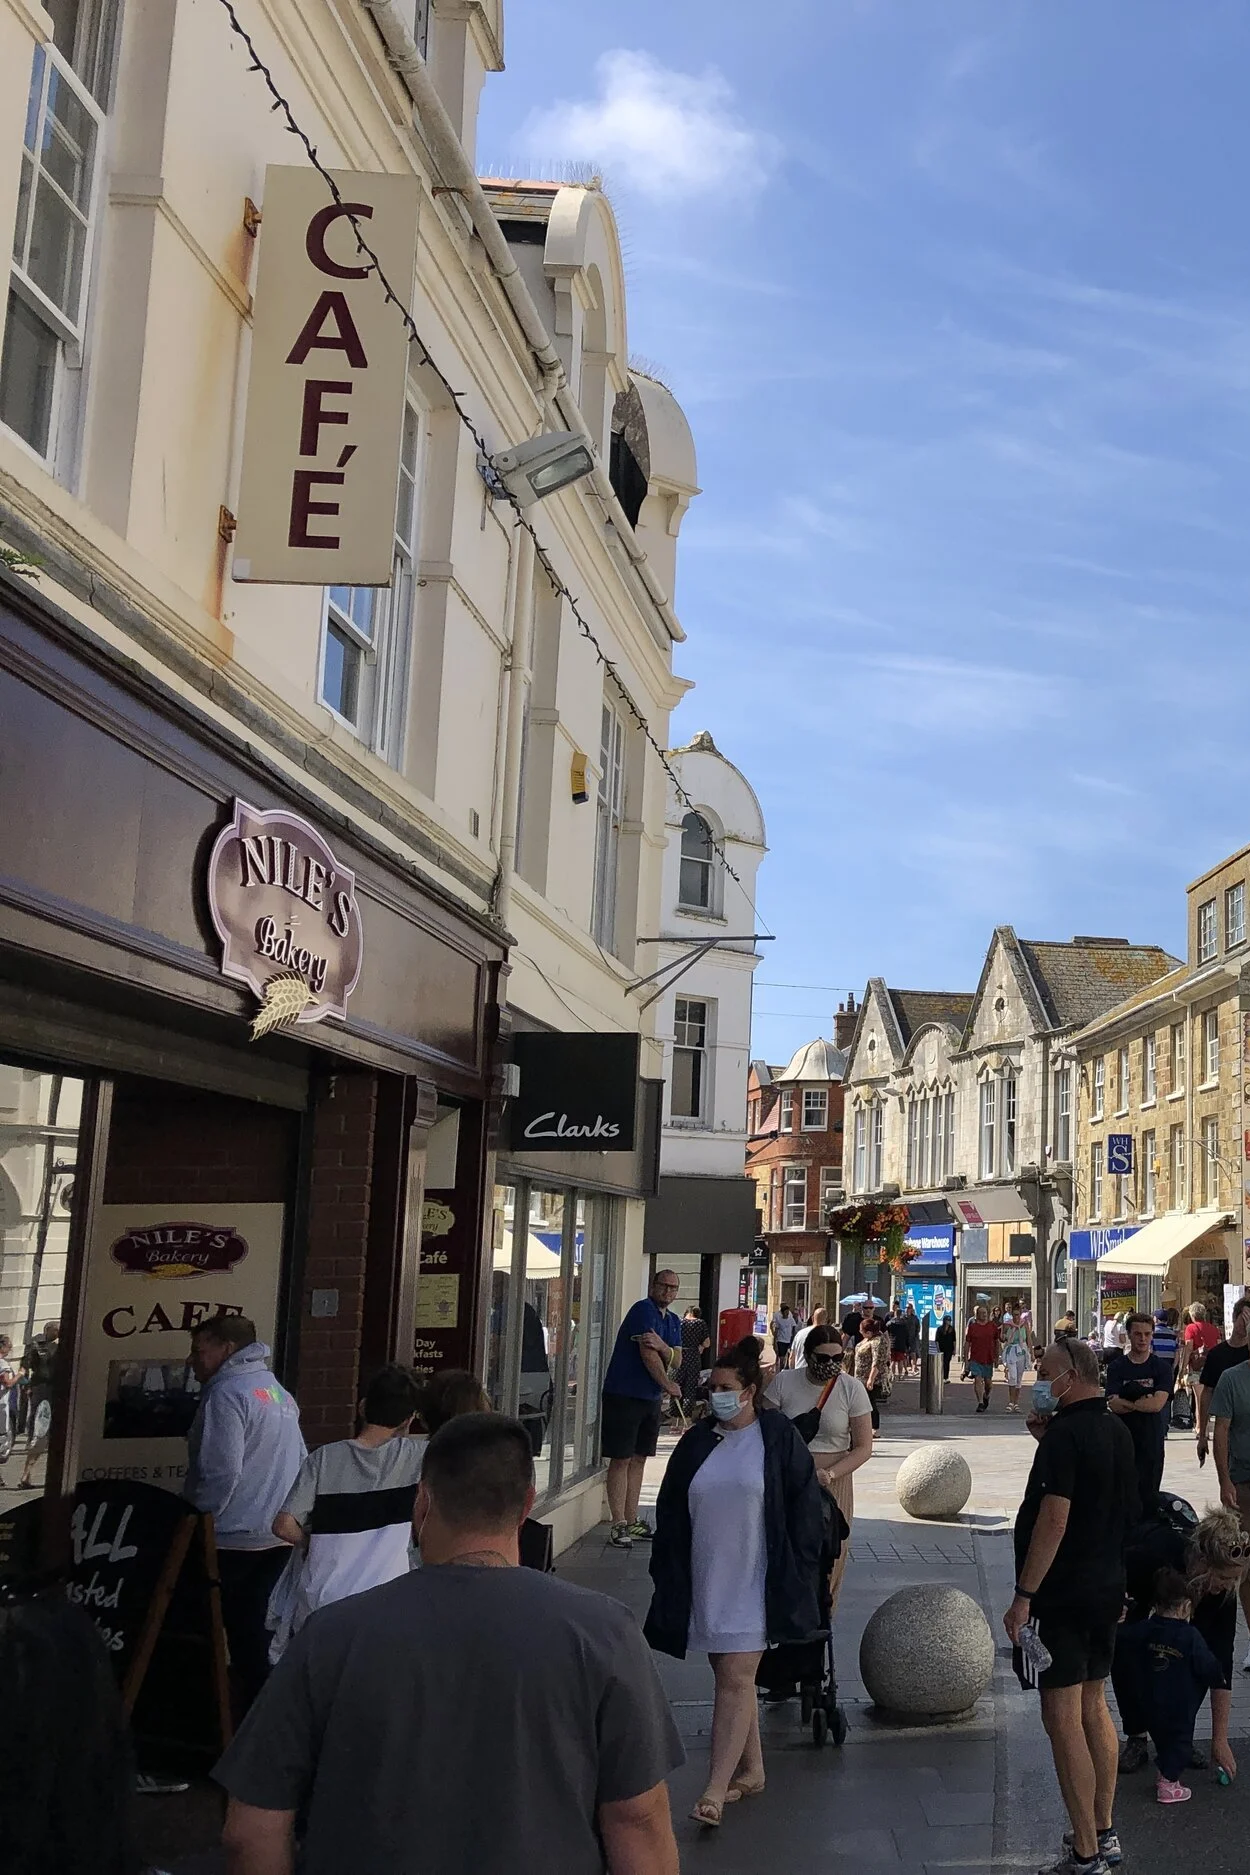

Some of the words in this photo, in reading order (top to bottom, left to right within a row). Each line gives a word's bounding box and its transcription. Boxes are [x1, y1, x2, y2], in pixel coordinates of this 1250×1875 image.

[239, 834, 352, 938] NILE'S
[256, 915, 329, 993] Bakery
[524, 1112, 620, 1138] Clarks
[1112, 1137, 1128, 1145] WH
[1112, 1144, 1130, 1172] S
[130, 1230, 230, 1249] NILE'S
[921, 1236, 950, 1249] Warehouse
[146, 1250, 211, 1266] Bakery
[416, 1339, 436, 1349] Day
[414, 1349, 444, 1358] kfasts
[82, 1465, 148, 1481] COFFEES
